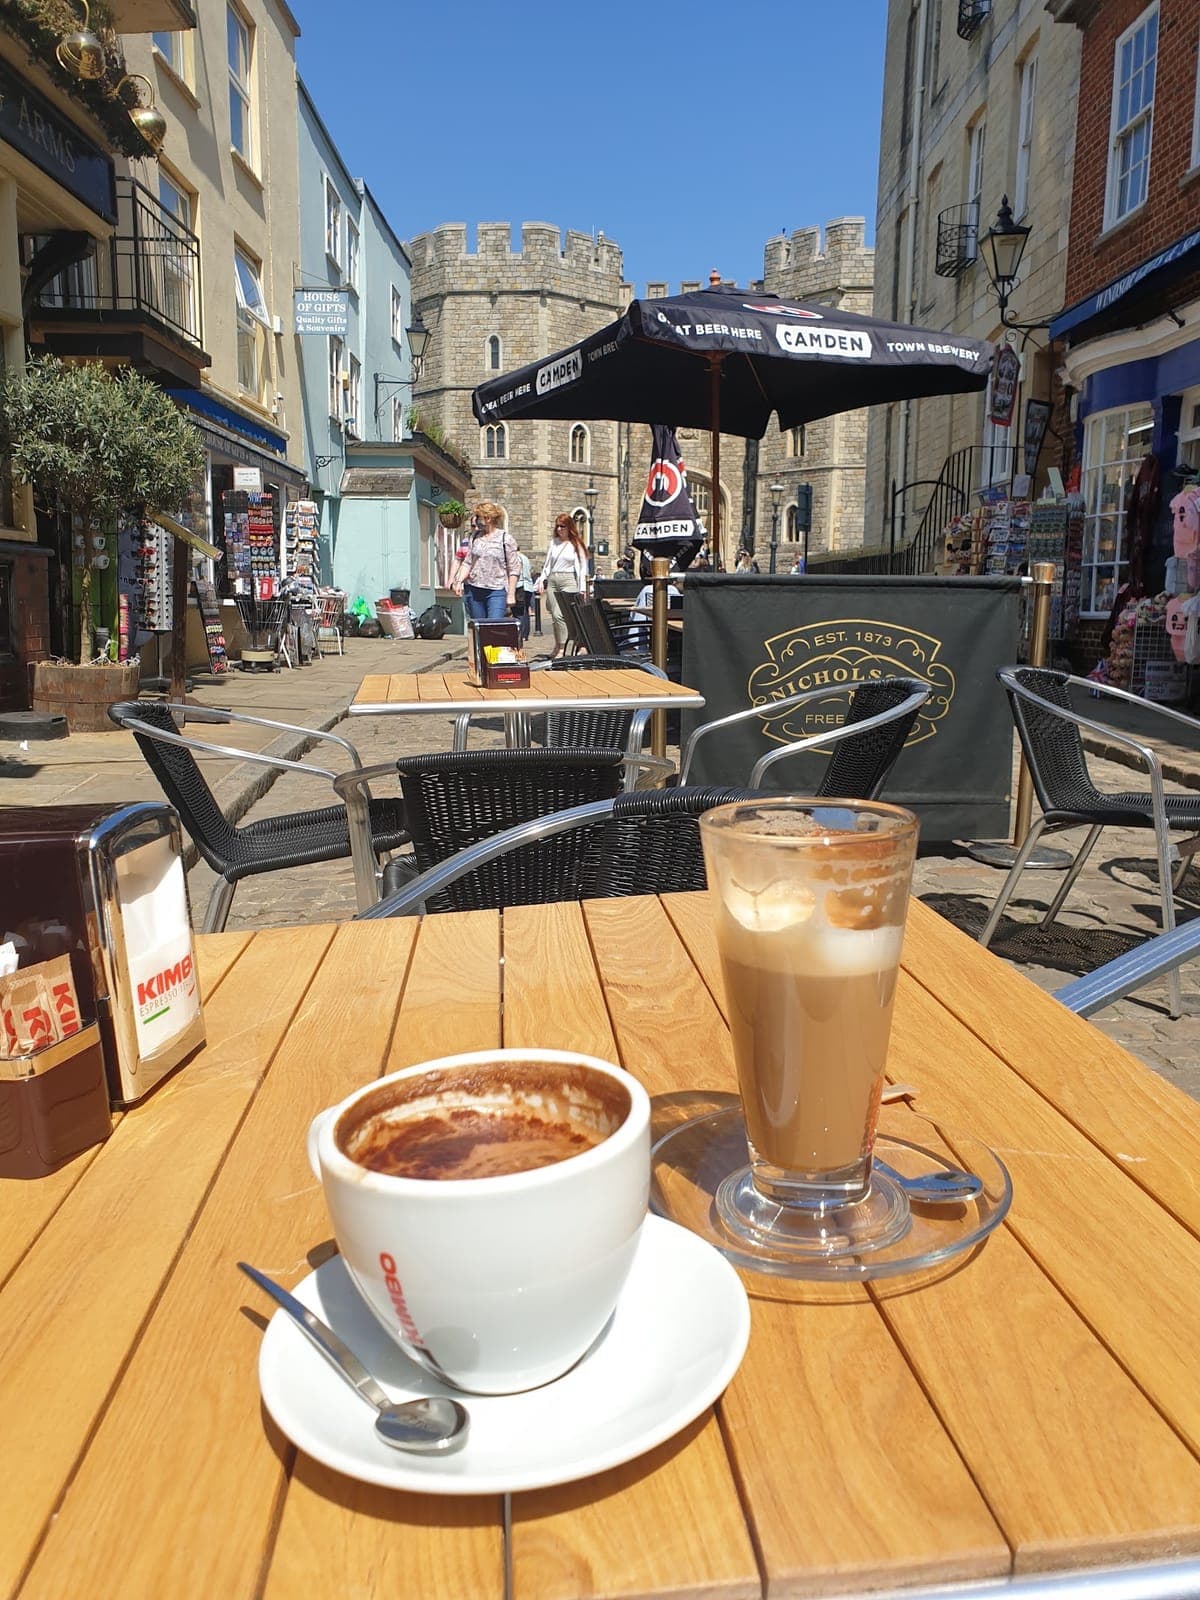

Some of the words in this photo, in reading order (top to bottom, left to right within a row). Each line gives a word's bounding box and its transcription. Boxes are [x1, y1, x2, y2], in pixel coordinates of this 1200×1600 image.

[18, 95, 76, 173] ARMS
[297, 303, 313, 312] OF
[314, 303, 346, 313] GIFTS
[303, 292, 341, 302] HOUSE
[296, 315, 325, 325] Quality
[327, 316, 347, 324] Gifts
[297, 324, 305, 332] &
[306, 324, 346, 332] Souvenirs
[657, 312, 692, 336] GAT
[695, 324, 731, 335] BEER
[730, 327, 762, 340] HERE
[784, 331, 864, 351] CAMDEN
[887, 342, 925, 352] TOWN
[927, 343, 980, 361] BREWERY
[540, 356, 579, 387] CAMDEN
[602, 340, 619, 356] BRE
[813, 631, 848, 647] EST.
[855, 631, 892, 647] 1873
[769, 667, 896, 702] NICHOLS
[805, 714, 845, 724] FREE
[137, 953, 193, 1006] KIMB
[140, 989, 178, 1017] ESPRESSO
